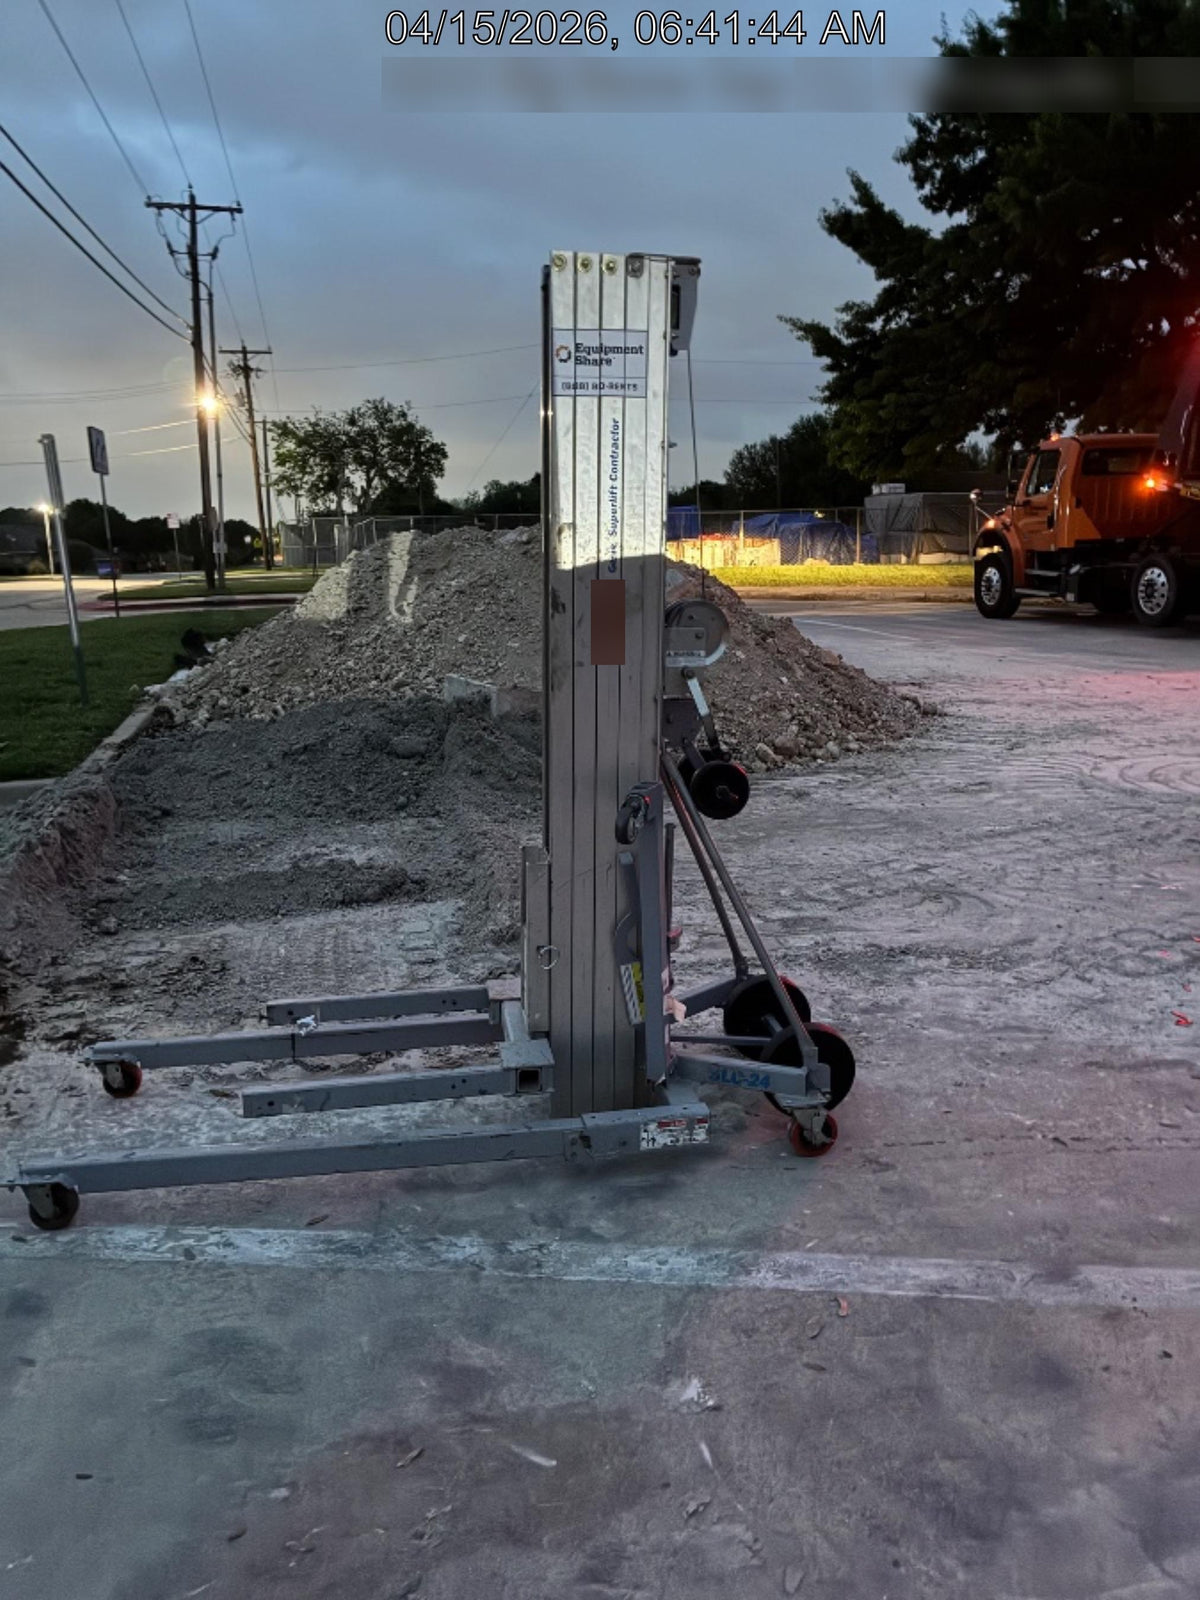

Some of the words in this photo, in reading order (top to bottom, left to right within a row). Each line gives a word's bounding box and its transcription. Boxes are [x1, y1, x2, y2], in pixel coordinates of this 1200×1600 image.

[575, 343, 644, 356] Equipment
[575, 355, 612, 366] Share
[608, 418, 621, 482] Contractor
[608, 485, 620, 537] Superlift
